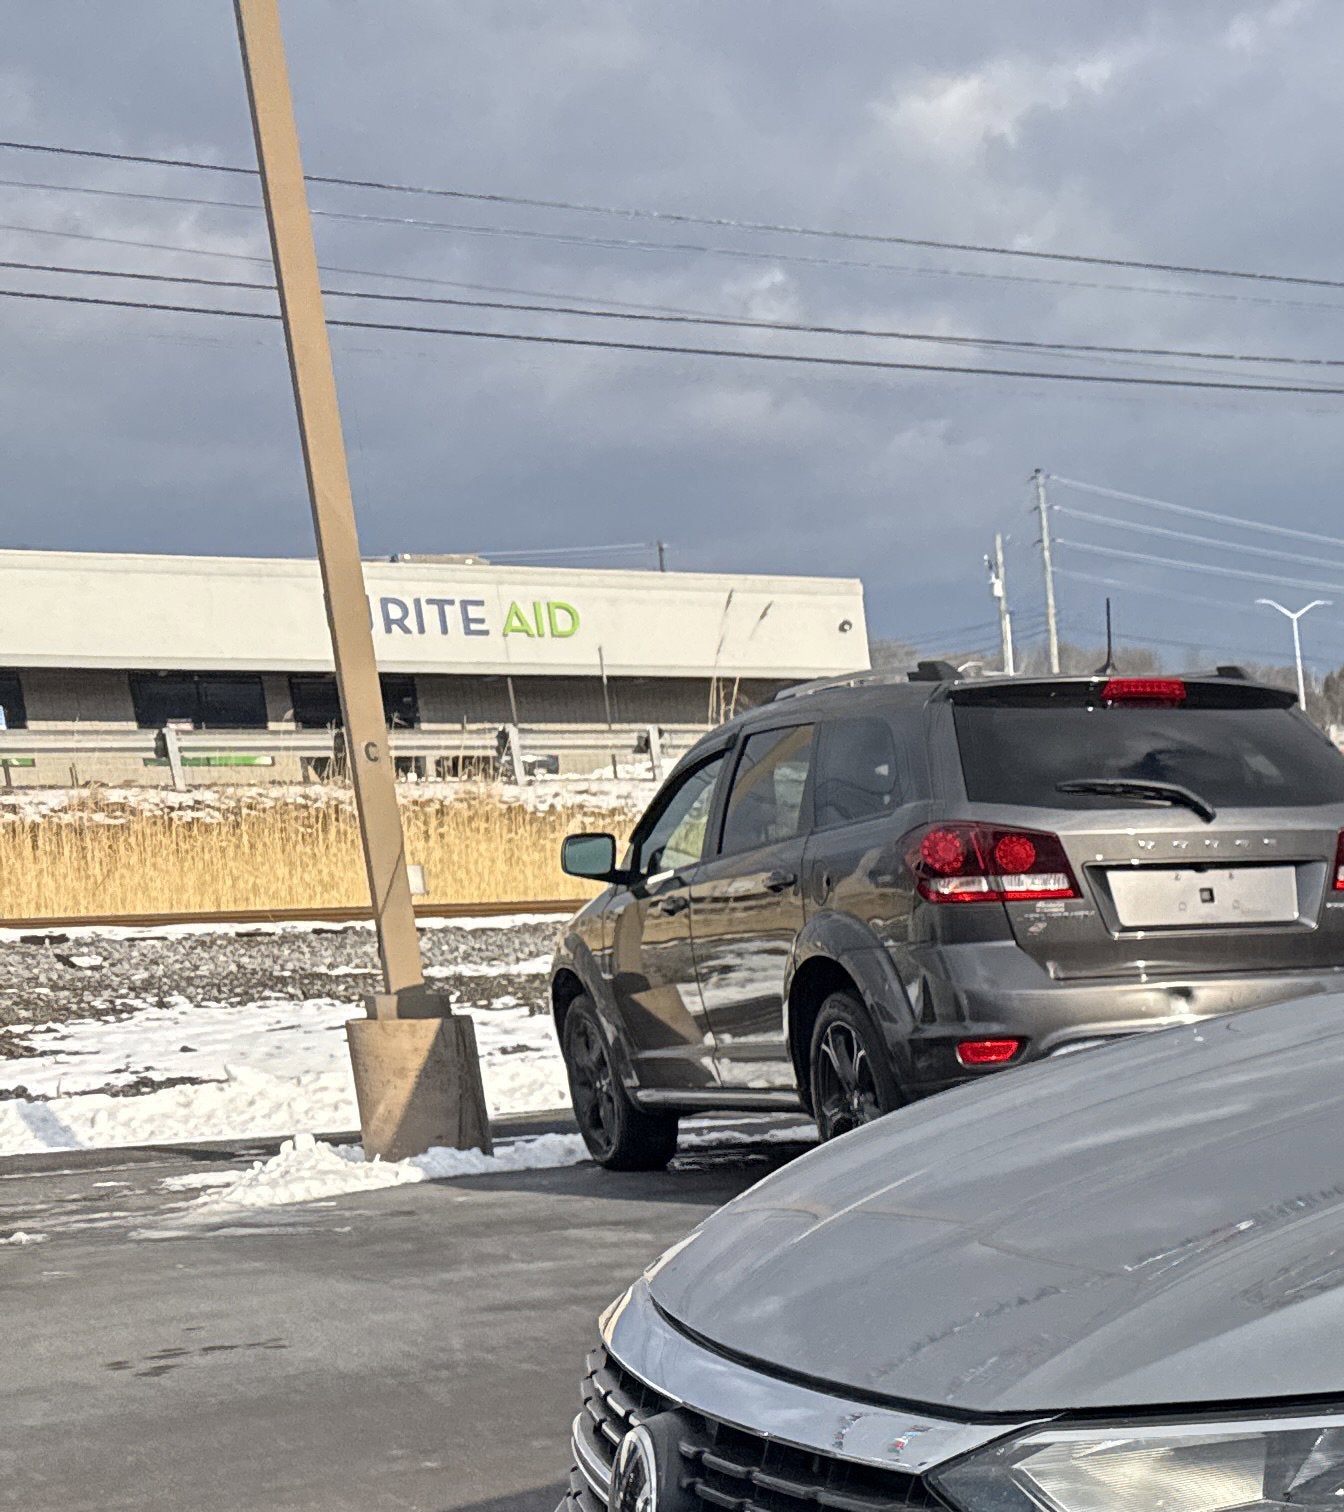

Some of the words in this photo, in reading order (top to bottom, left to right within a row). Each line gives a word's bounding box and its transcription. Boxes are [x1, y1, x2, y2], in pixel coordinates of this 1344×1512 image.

[379, 597, 490, 636] RITE
[502, 600, 581, 638] AID
[364, 741, 379, 762] C
